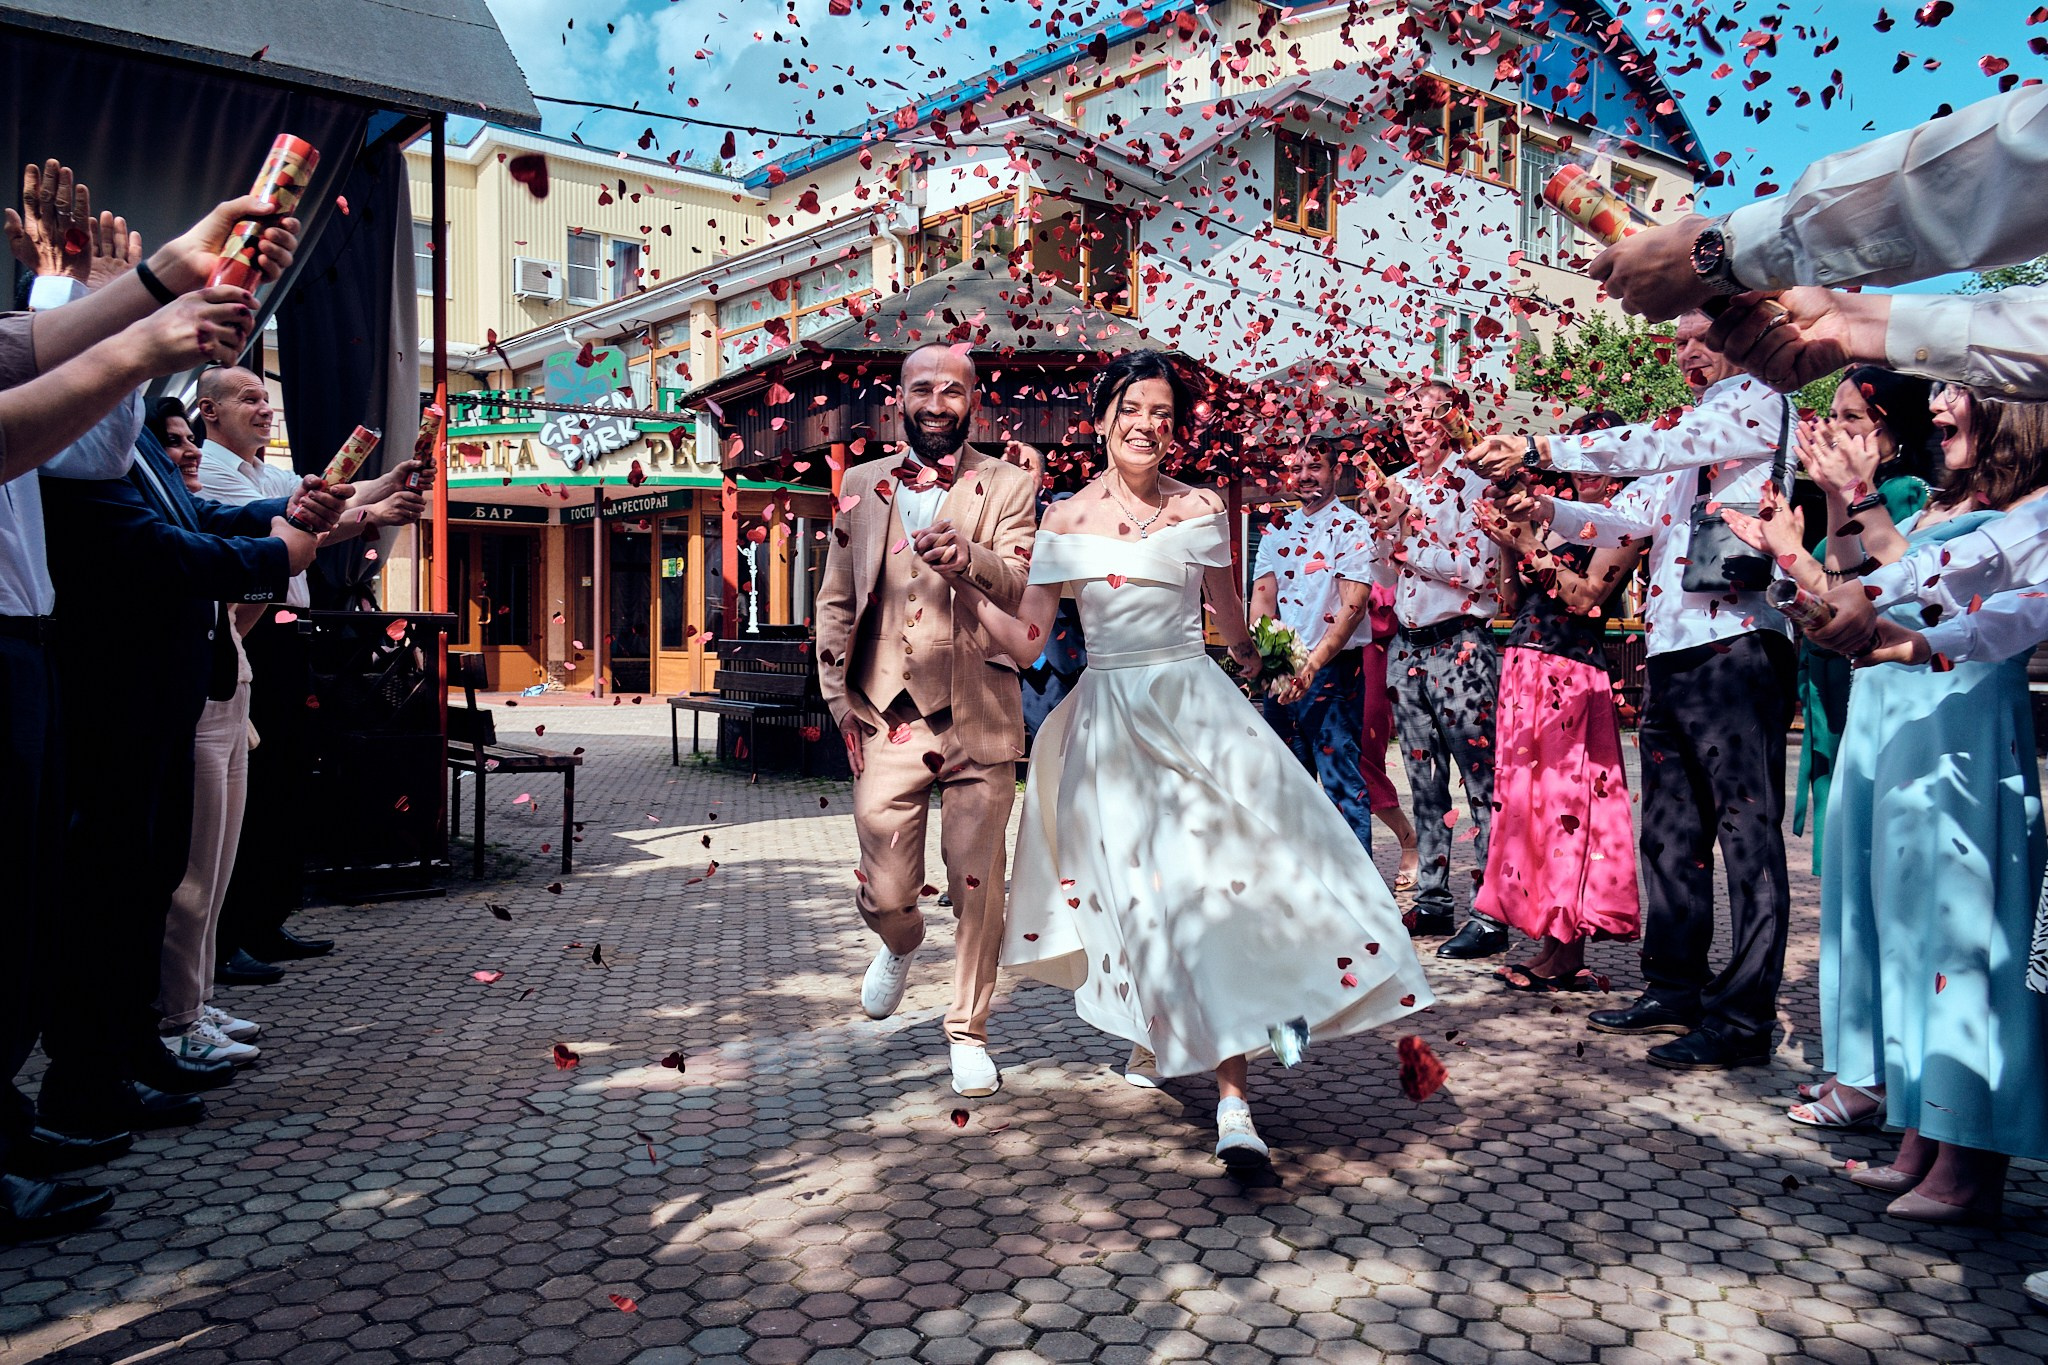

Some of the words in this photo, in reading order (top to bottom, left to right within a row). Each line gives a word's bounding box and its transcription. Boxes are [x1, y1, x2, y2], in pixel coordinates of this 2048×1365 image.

[448, 388, 534, 422] РИН
[540, 391, 634, 446] GREEN
[557, 416, 640, 470] PARK
[474, 506, 514, 519] БАР
[570, 502, 618, 520] ГОСТИЦА
[622, 495, 669, 514] РЕСТОРАН
